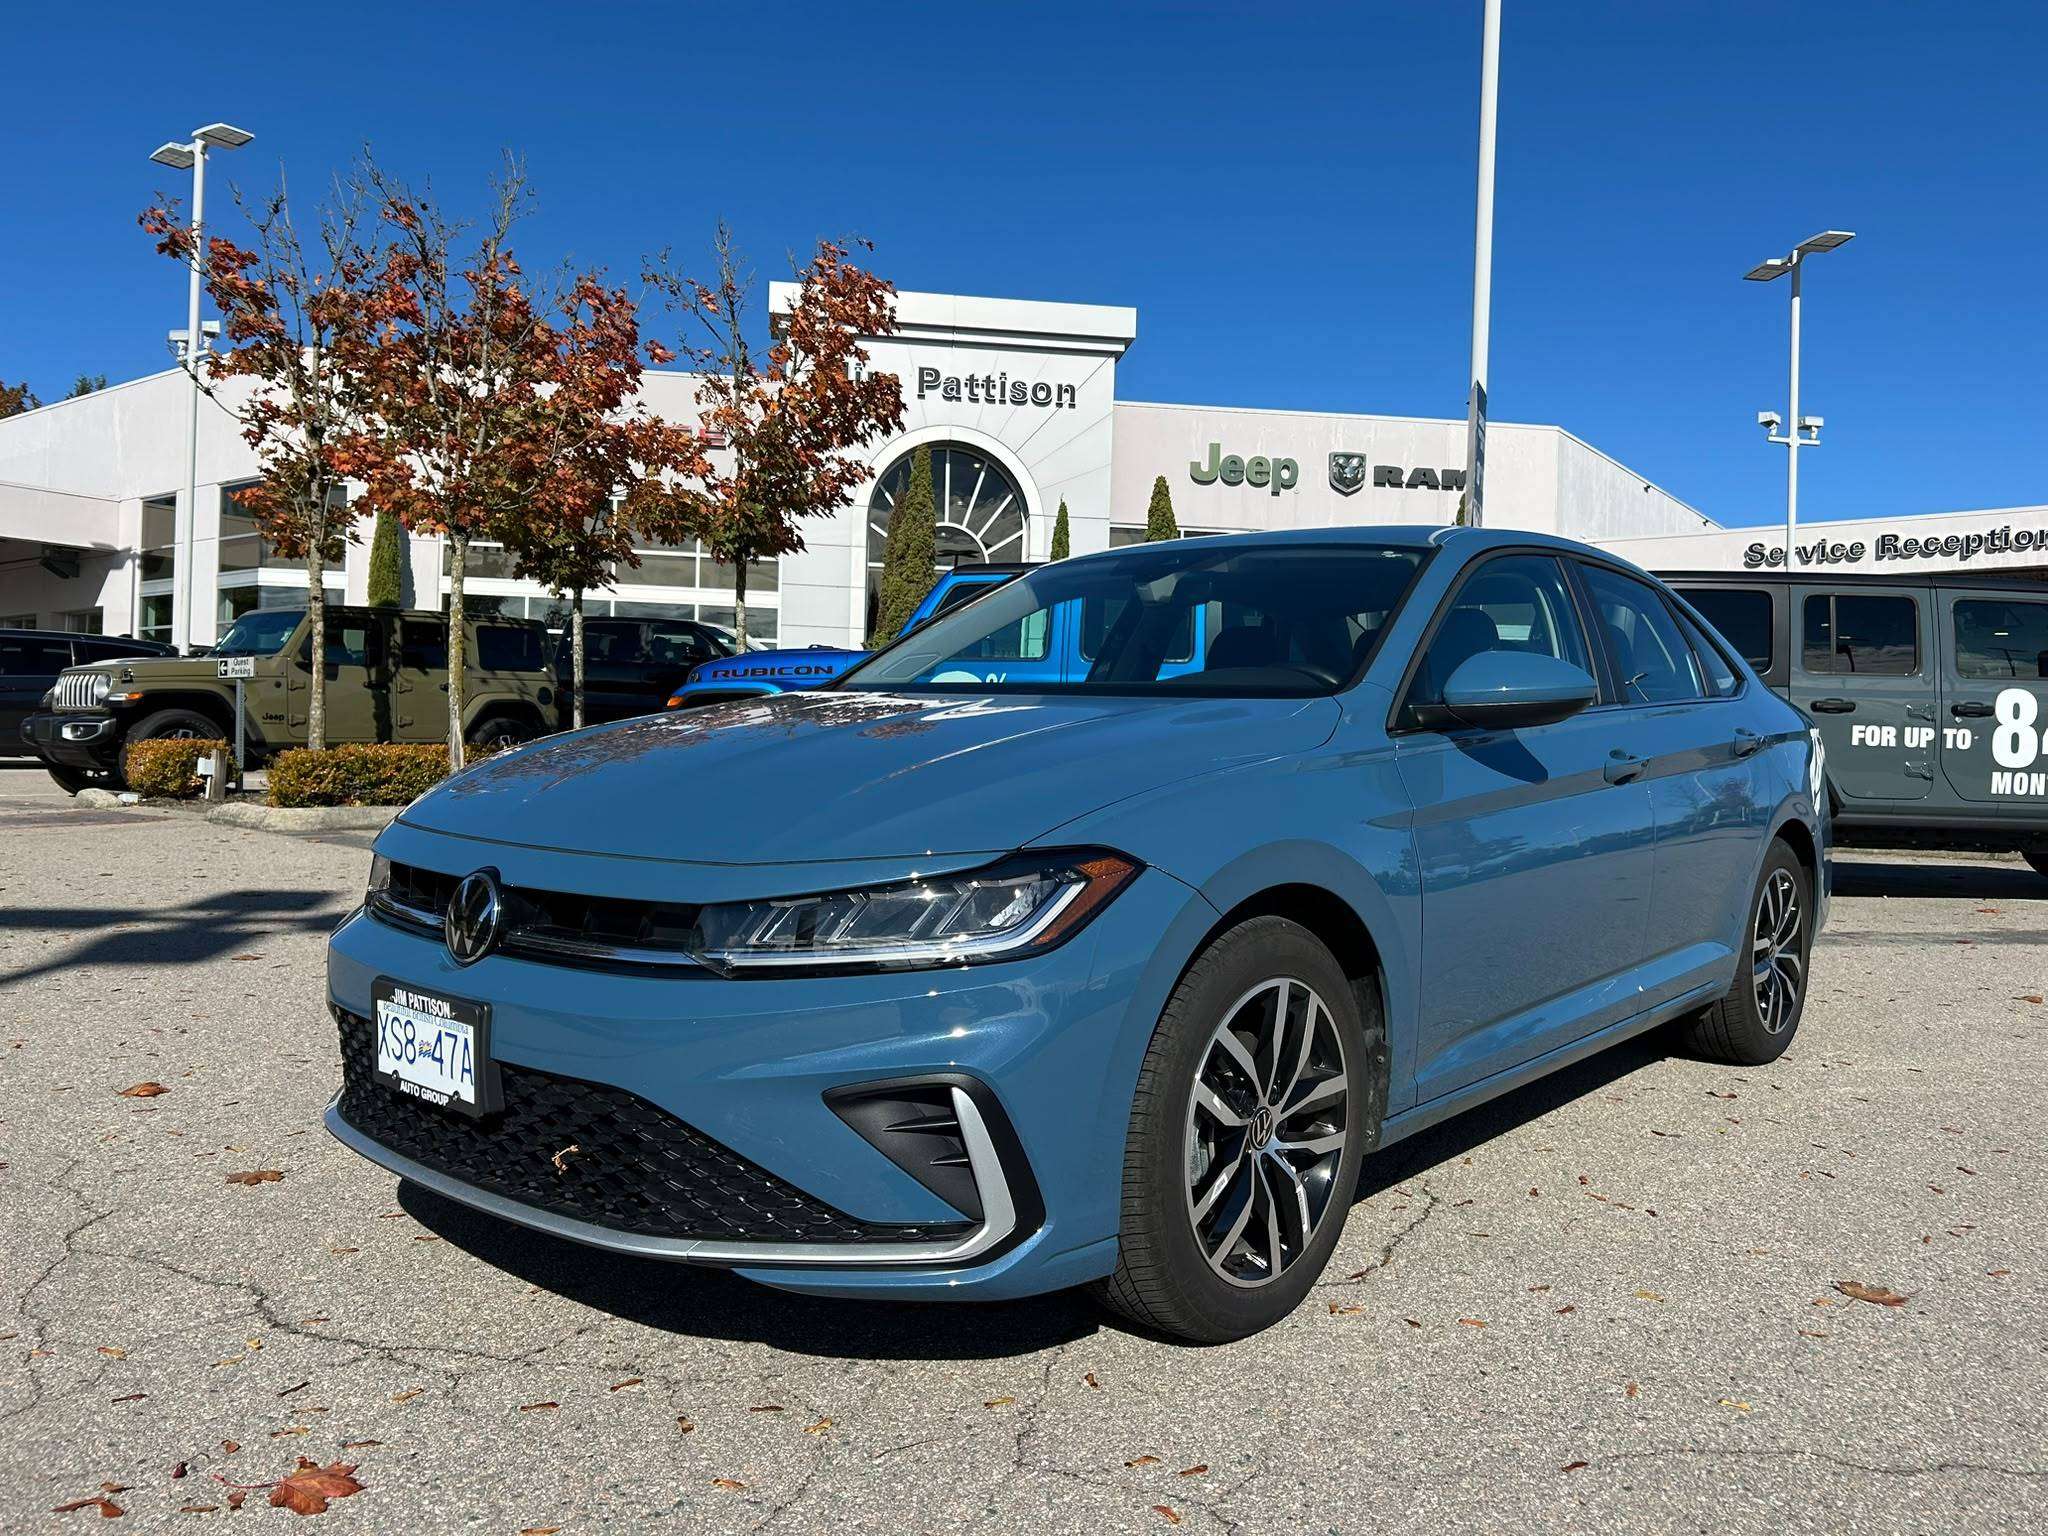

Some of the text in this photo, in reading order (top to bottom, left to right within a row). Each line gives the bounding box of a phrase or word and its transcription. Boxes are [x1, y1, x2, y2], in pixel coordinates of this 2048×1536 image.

[916, 366, 1076, 407] Pattison
[1189, 442, 1299, 496] Jeep
[231, 667, 251, 677] Parking
[712, 665, 833, 679] RUBICON
[262, 712, 285, 721] Jeep
[1992, 688, 2048, 768] 8
[1851, 725, 1972, 750] FOR UP TO
[1991, 772, 2048, 795] MON
[393, 988, 407, 1007] JIM
[408, 992, 450, 1019] PATTISON
[378, 1010, 416, 1065] XS8
[431, 1029, 474, 1086] 47A
[400, 1080, 450, 1106] AUTO GROUP
